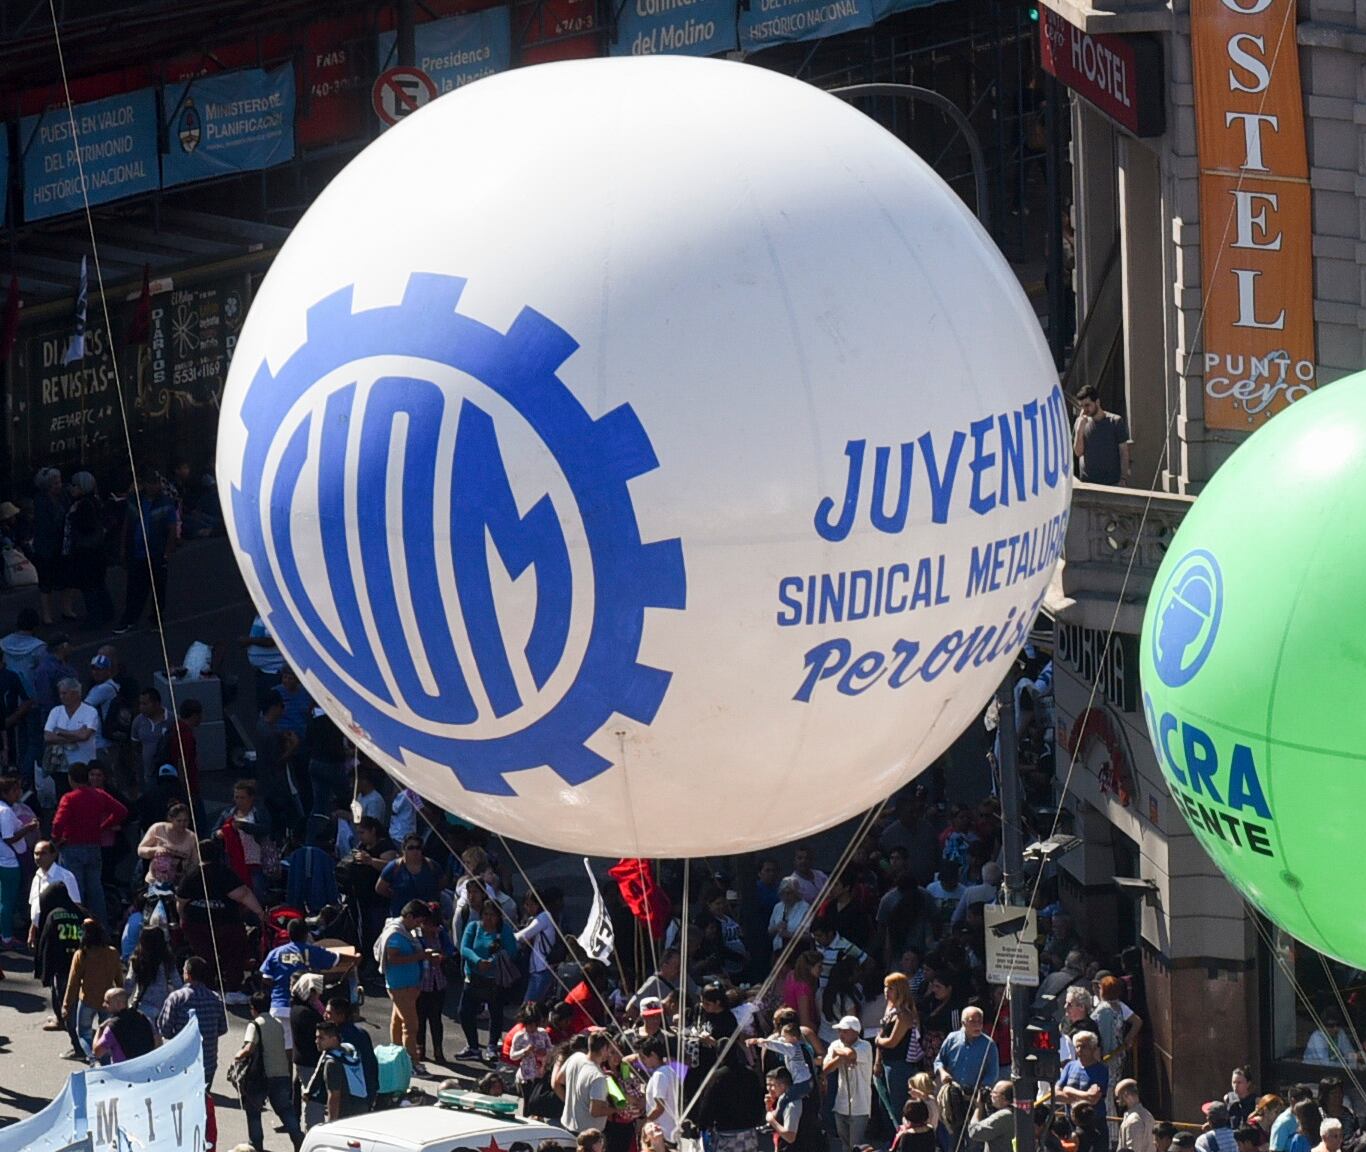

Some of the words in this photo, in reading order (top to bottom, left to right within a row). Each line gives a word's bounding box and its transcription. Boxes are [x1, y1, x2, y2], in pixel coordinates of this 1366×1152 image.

[632, 29, 656, 55] del
[660, 20, 714, 52] Molino
[1071, 24, 1130, 108] HOSTEL
[81, 116, 97, 132] EN
[99, 106, 134, 130] VALOR
[44, 154, 64, 173] DEL
[67, 136, 133, 168] PATRIMONIO
[1223, 0, 1285, 330] STEL
[92, 161, 146, 188] NACIONAL
[1204, 352, 1314, 380] PUNTO
[777, 556, 949, 627] SINDICAL
